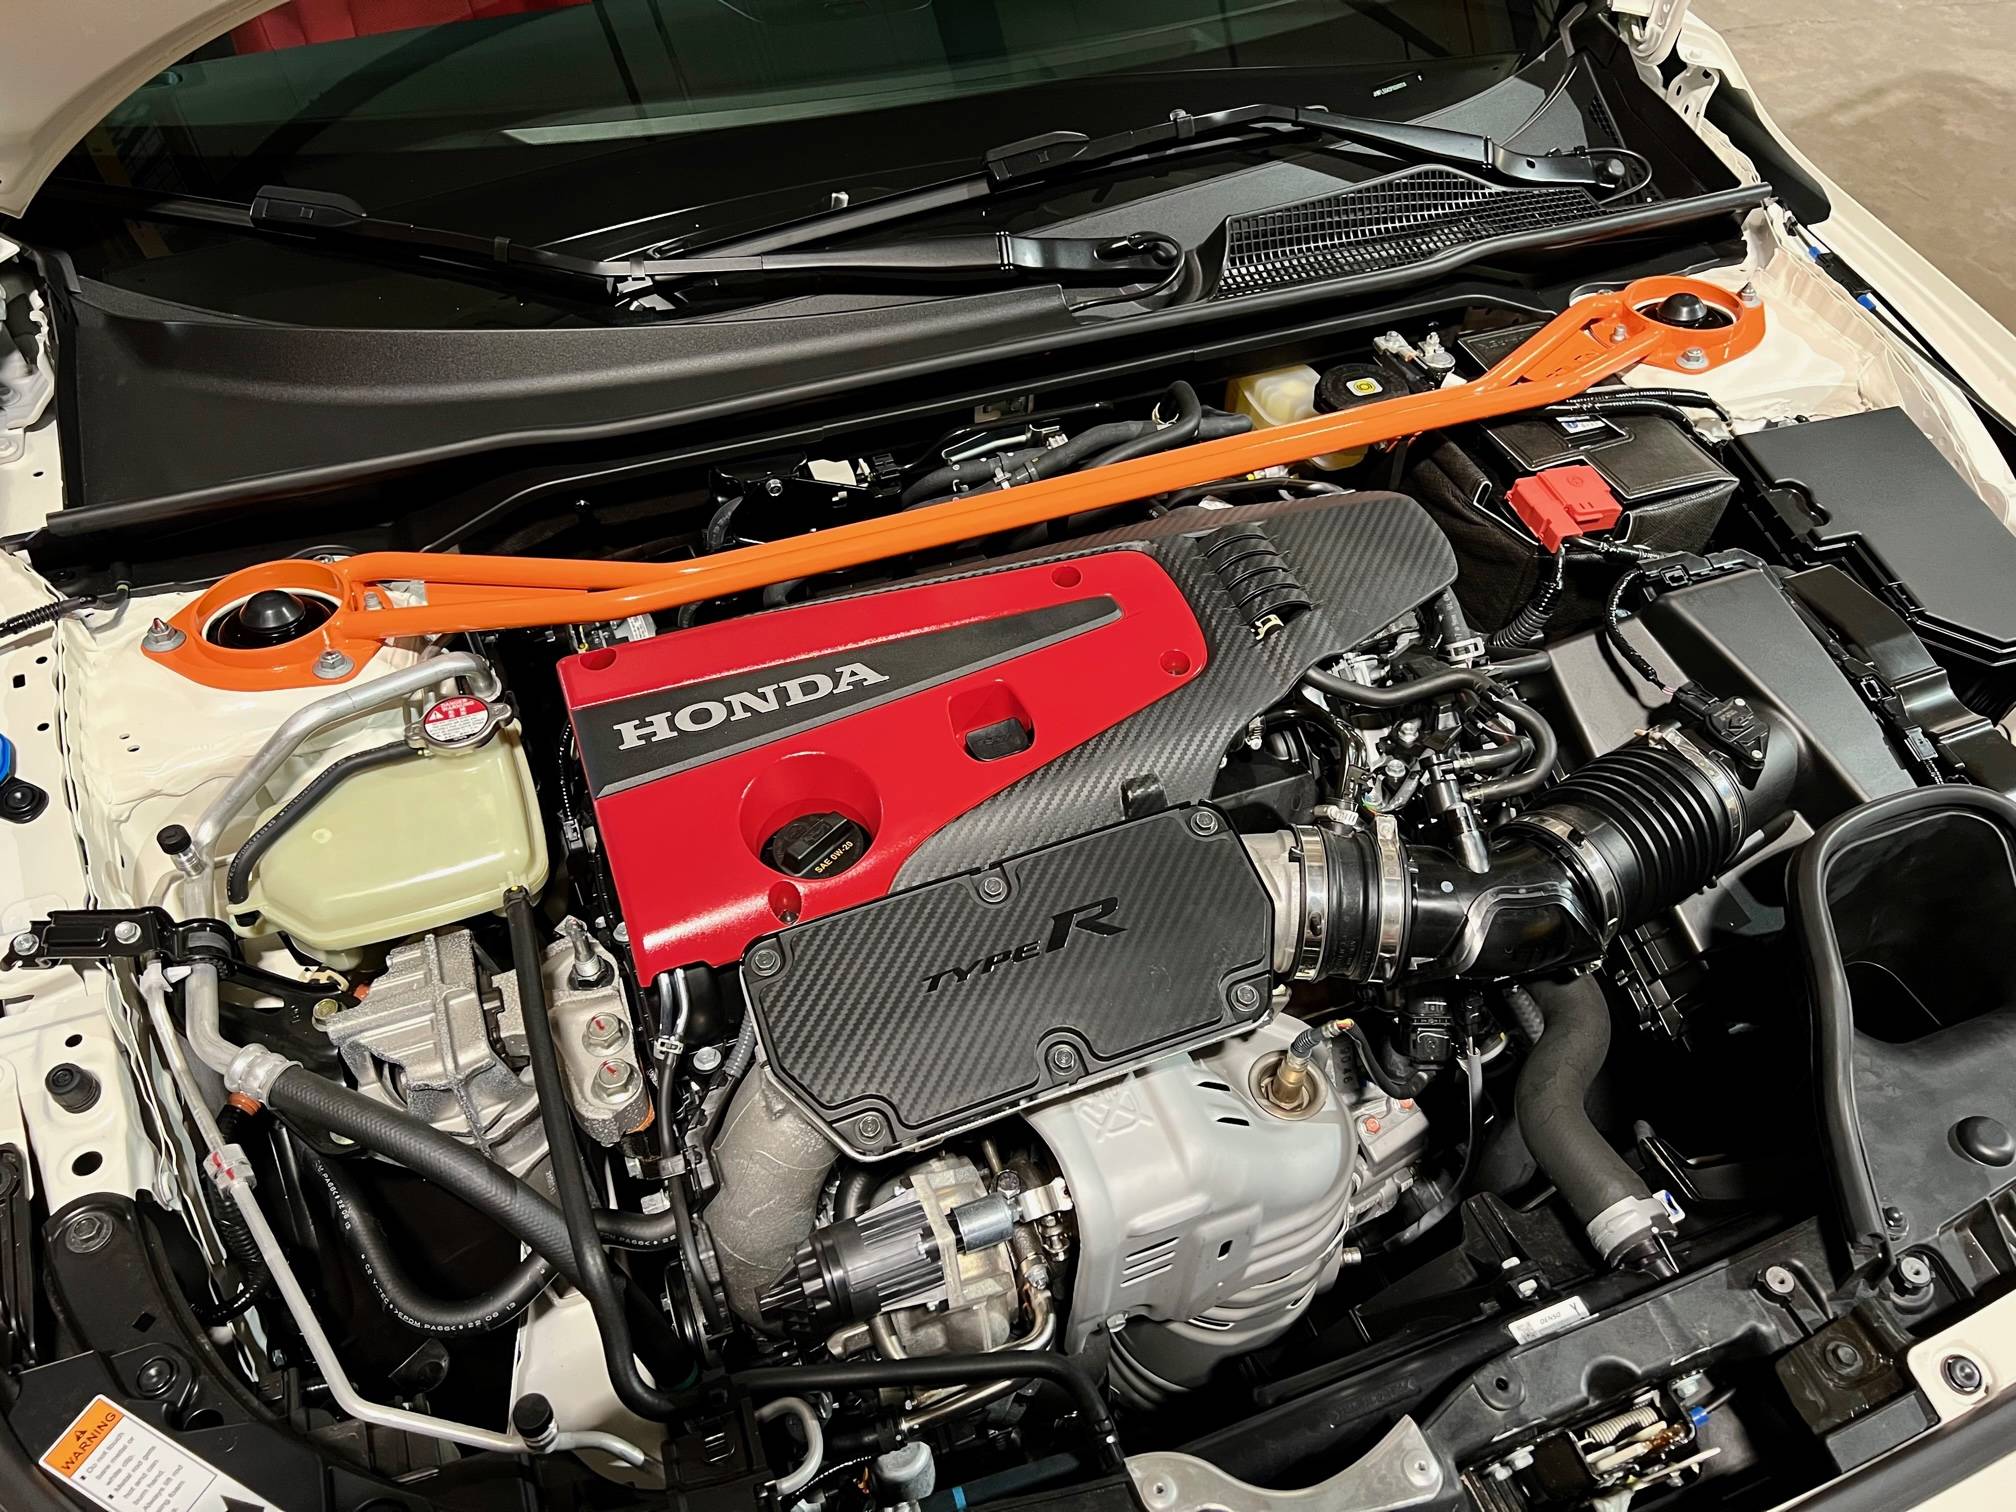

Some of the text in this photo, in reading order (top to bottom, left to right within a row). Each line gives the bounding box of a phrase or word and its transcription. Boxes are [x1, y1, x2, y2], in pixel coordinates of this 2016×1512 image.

[613, 662, 889, 750] HONDA
[814, 841, 854, 873] SAE 0W-20
[922, 896, 1128, 993] TYPE R
[61, 1412, 116, 1469] WARNING
[86, 1463, 97, 1474] Do
